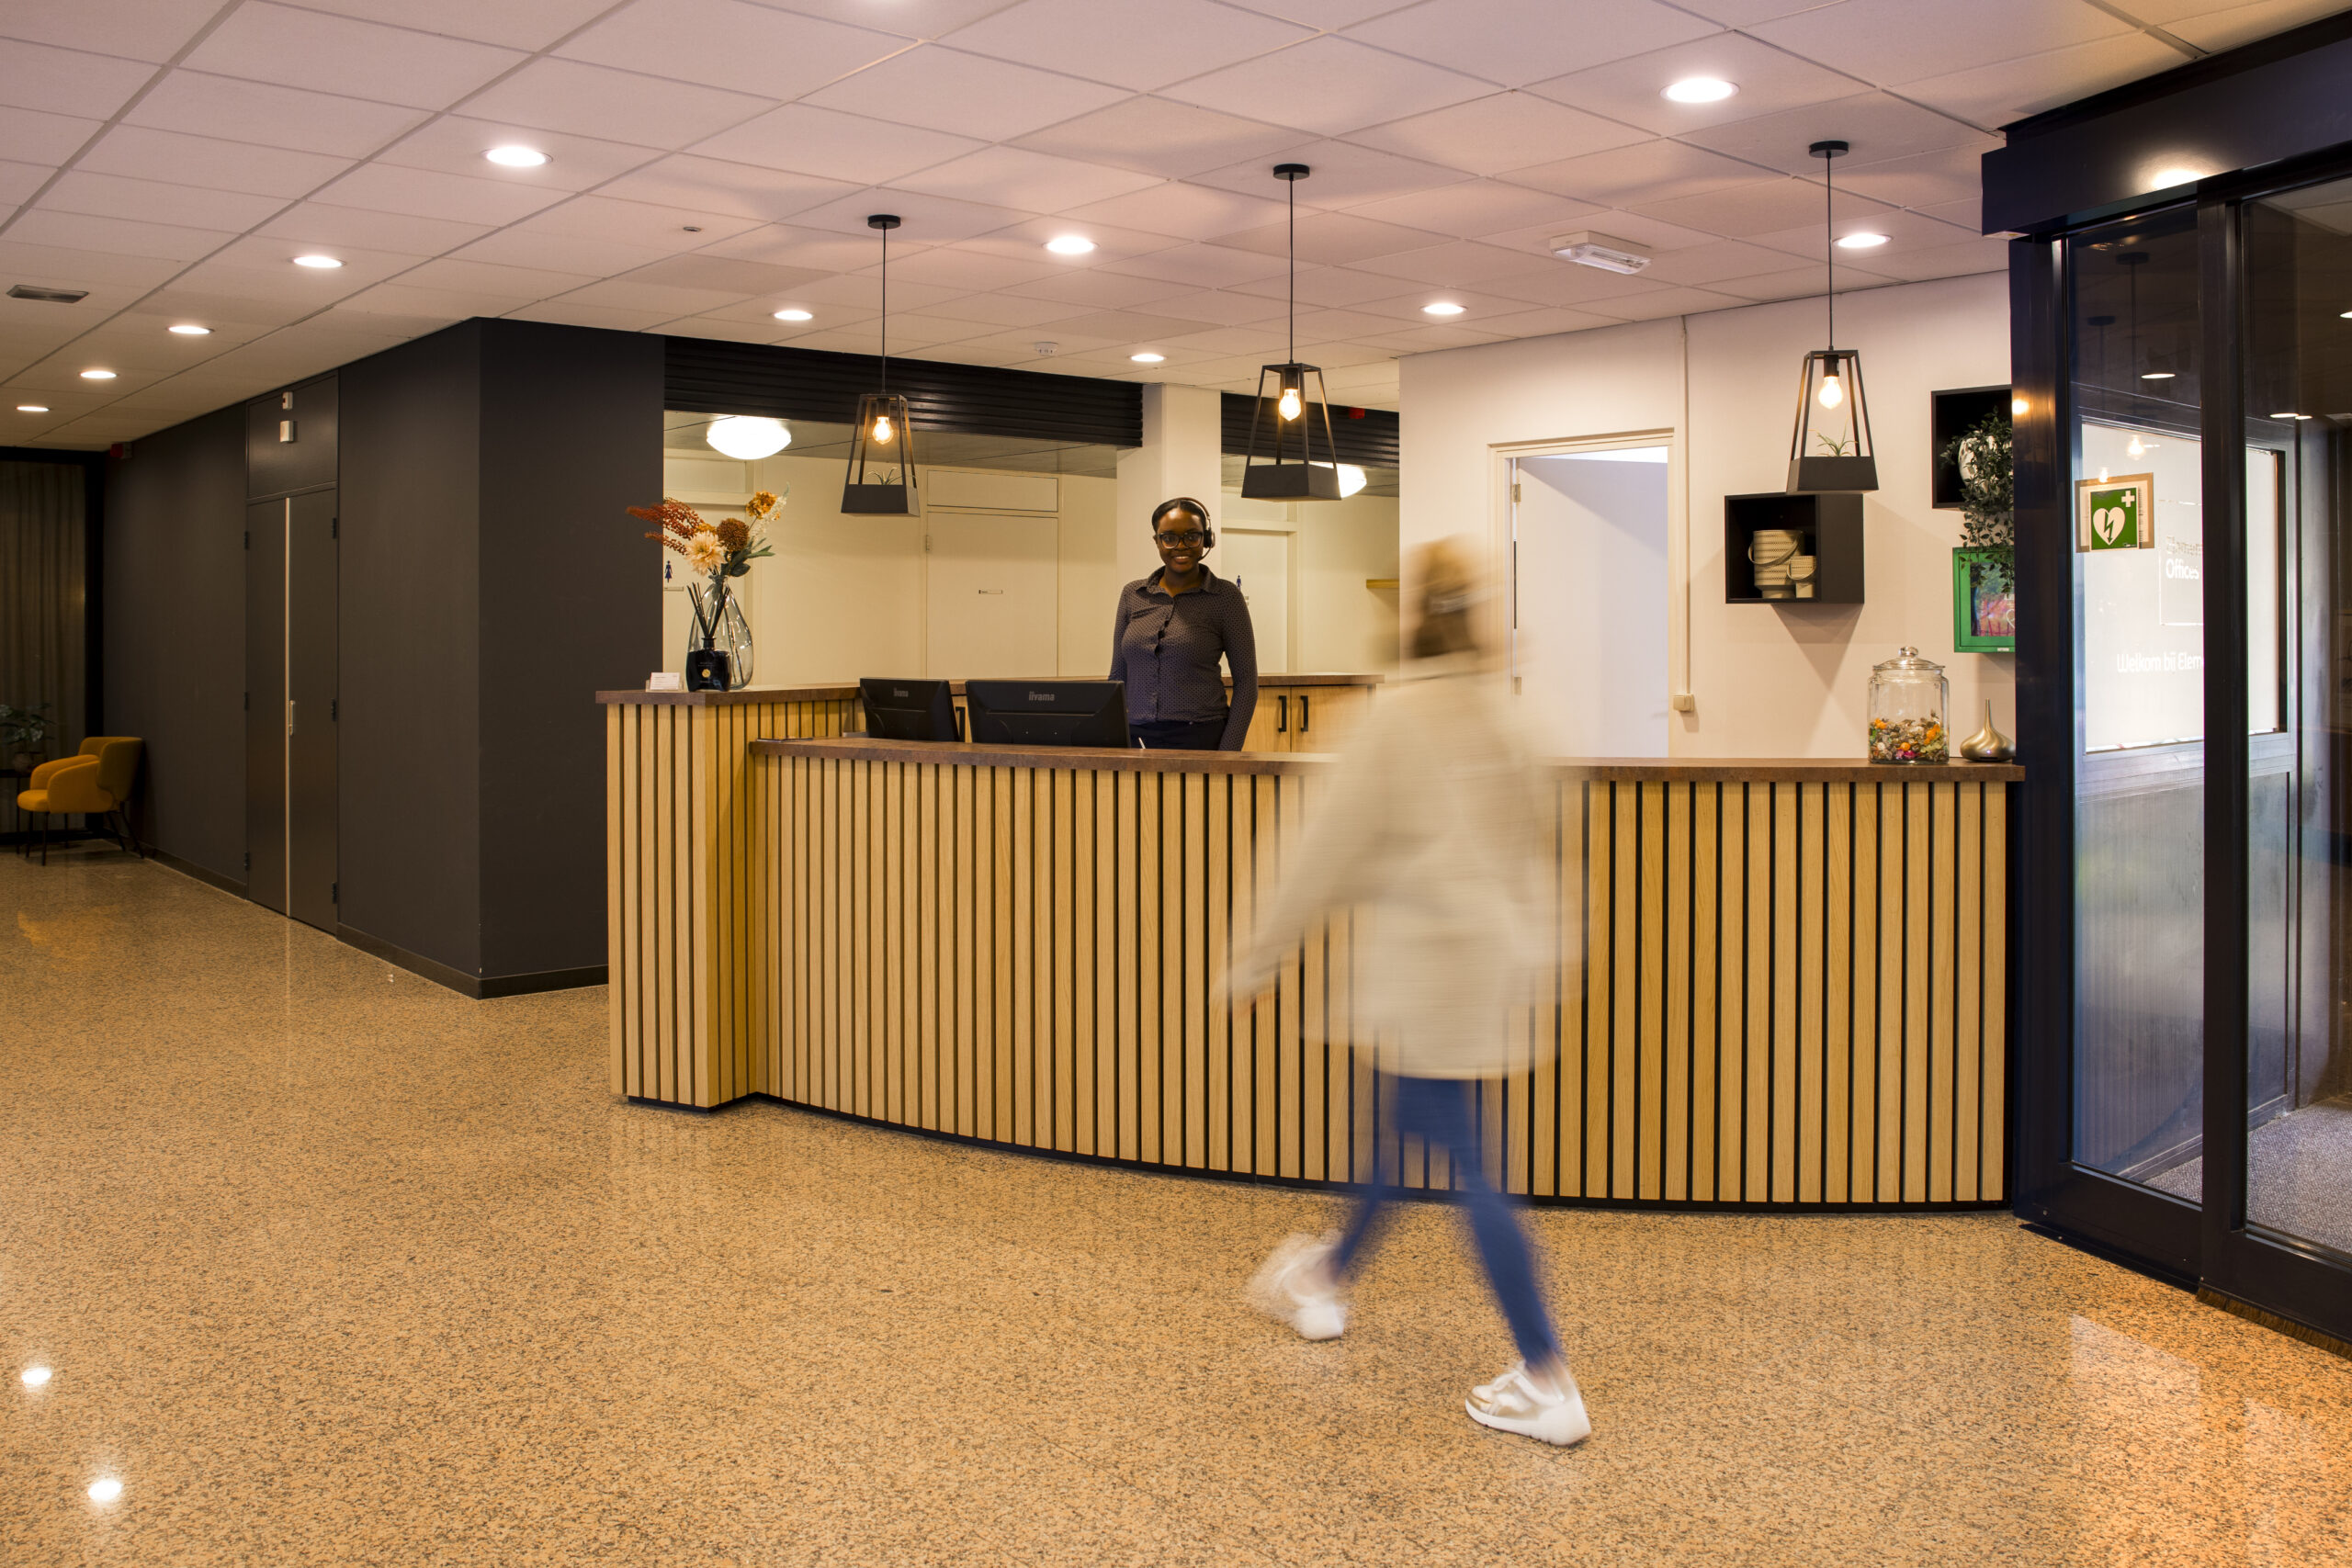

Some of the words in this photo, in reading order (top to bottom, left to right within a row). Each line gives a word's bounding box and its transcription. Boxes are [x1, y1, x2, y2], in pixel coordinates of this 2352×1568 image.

[2165, 558, 2199, 580] Offices
[2116, 652, 2161, 672] Welkom
[2177, 651, 2203, 671] Elem
